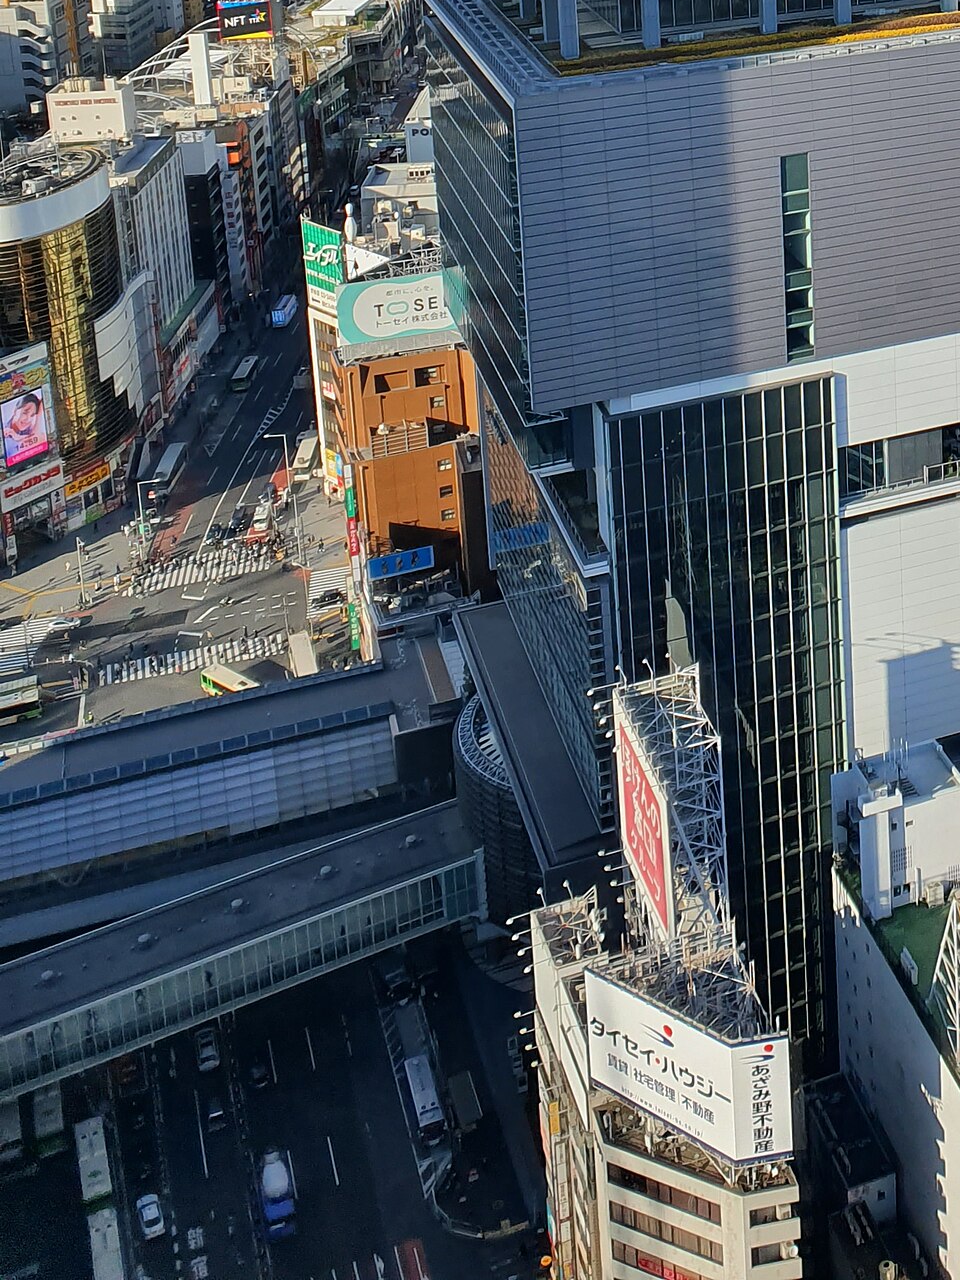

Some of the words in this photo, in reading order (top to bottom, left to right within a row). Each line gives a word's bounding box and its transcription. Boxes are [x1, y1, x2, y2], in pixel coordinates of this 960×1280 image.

[224, 15, 246, 28] NFT
[411, 128, 433, 137] PO
[373, 296, 447, 317] TOSE
[375, 311, 448, 329] トーセイ株式会社
[590, 1016, 732, 1104] タイセイ・ハウジー
[751, 1064, 775, 1154] あざみ野不動産
